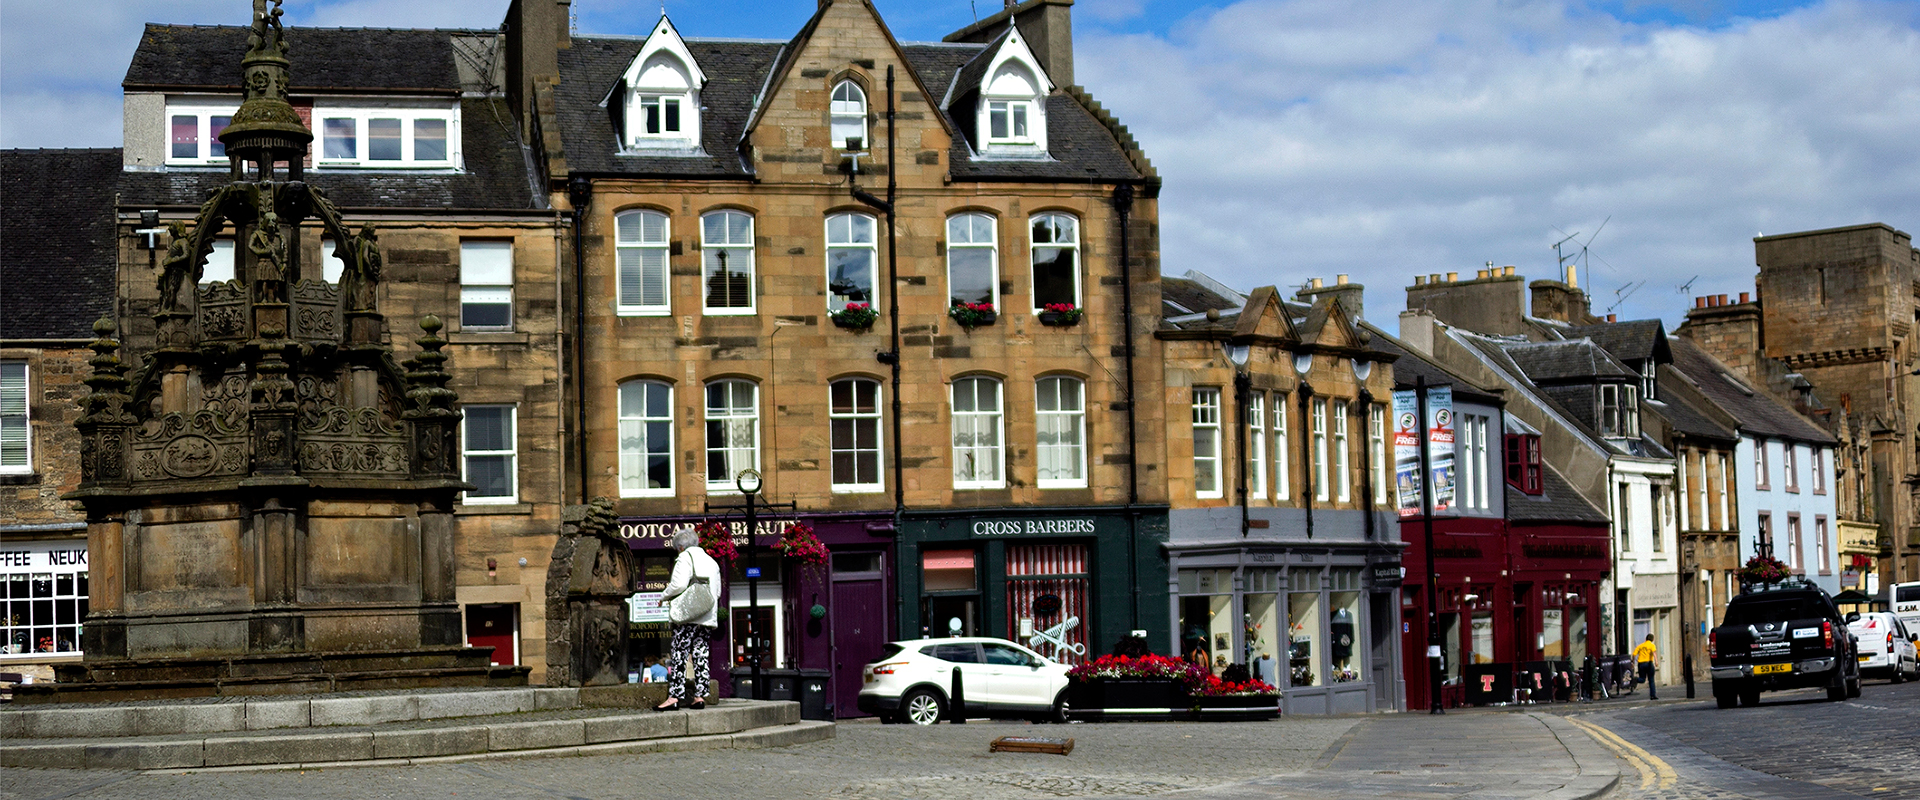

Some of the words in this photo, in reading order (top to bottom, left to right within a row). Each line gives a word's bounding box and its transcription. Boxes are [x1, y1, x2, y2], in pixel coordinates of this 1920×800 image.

[1395, 436, 1418, 445] FREE
[1431, 432, 1453, 441] FREE
[974, 521, 1021, 534] CROSS
[1026, 519, 1095, 533] BARBERS
[49, 550, 87, 565] NEUK
[1481, 674, 1495, 691] T
